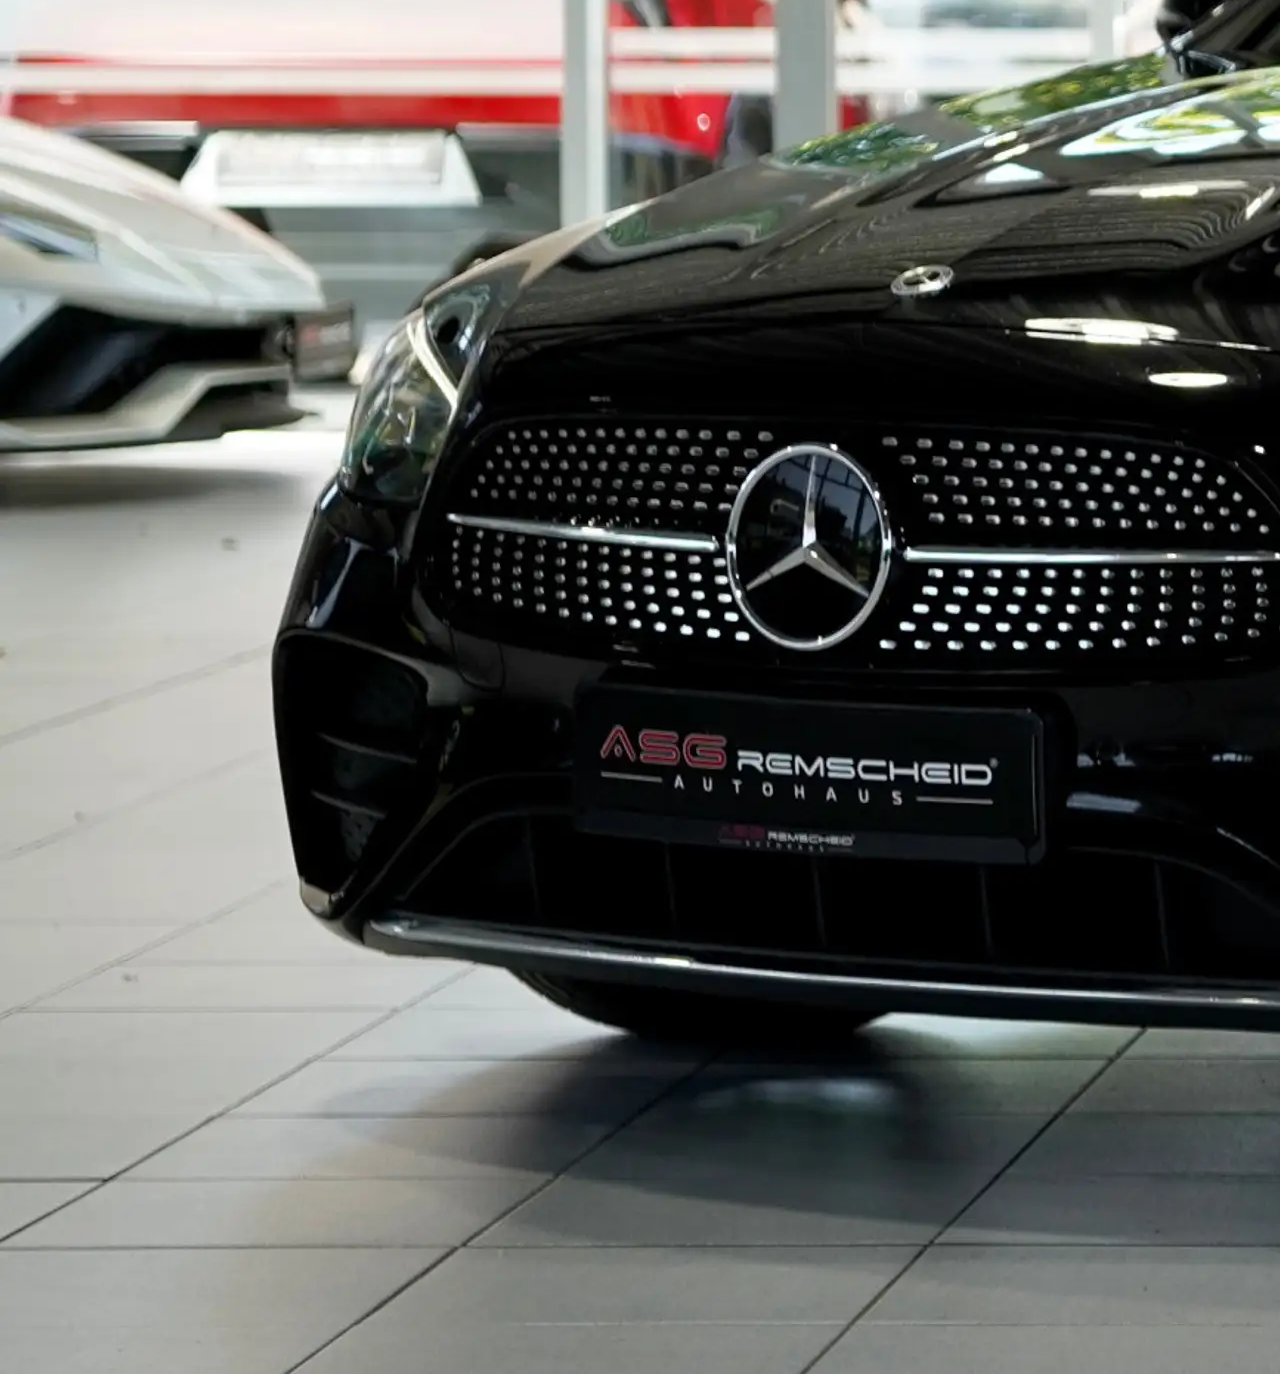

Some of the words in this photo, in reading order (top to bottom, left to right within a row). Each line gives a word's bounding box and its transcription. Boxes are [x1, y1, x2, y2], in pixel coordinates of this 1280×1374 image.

[600, 724, 727, 770] ASG
[737, 749, 993, 786] REMSCHEID
[674, 774, 904, 806] AUTOHAUS
